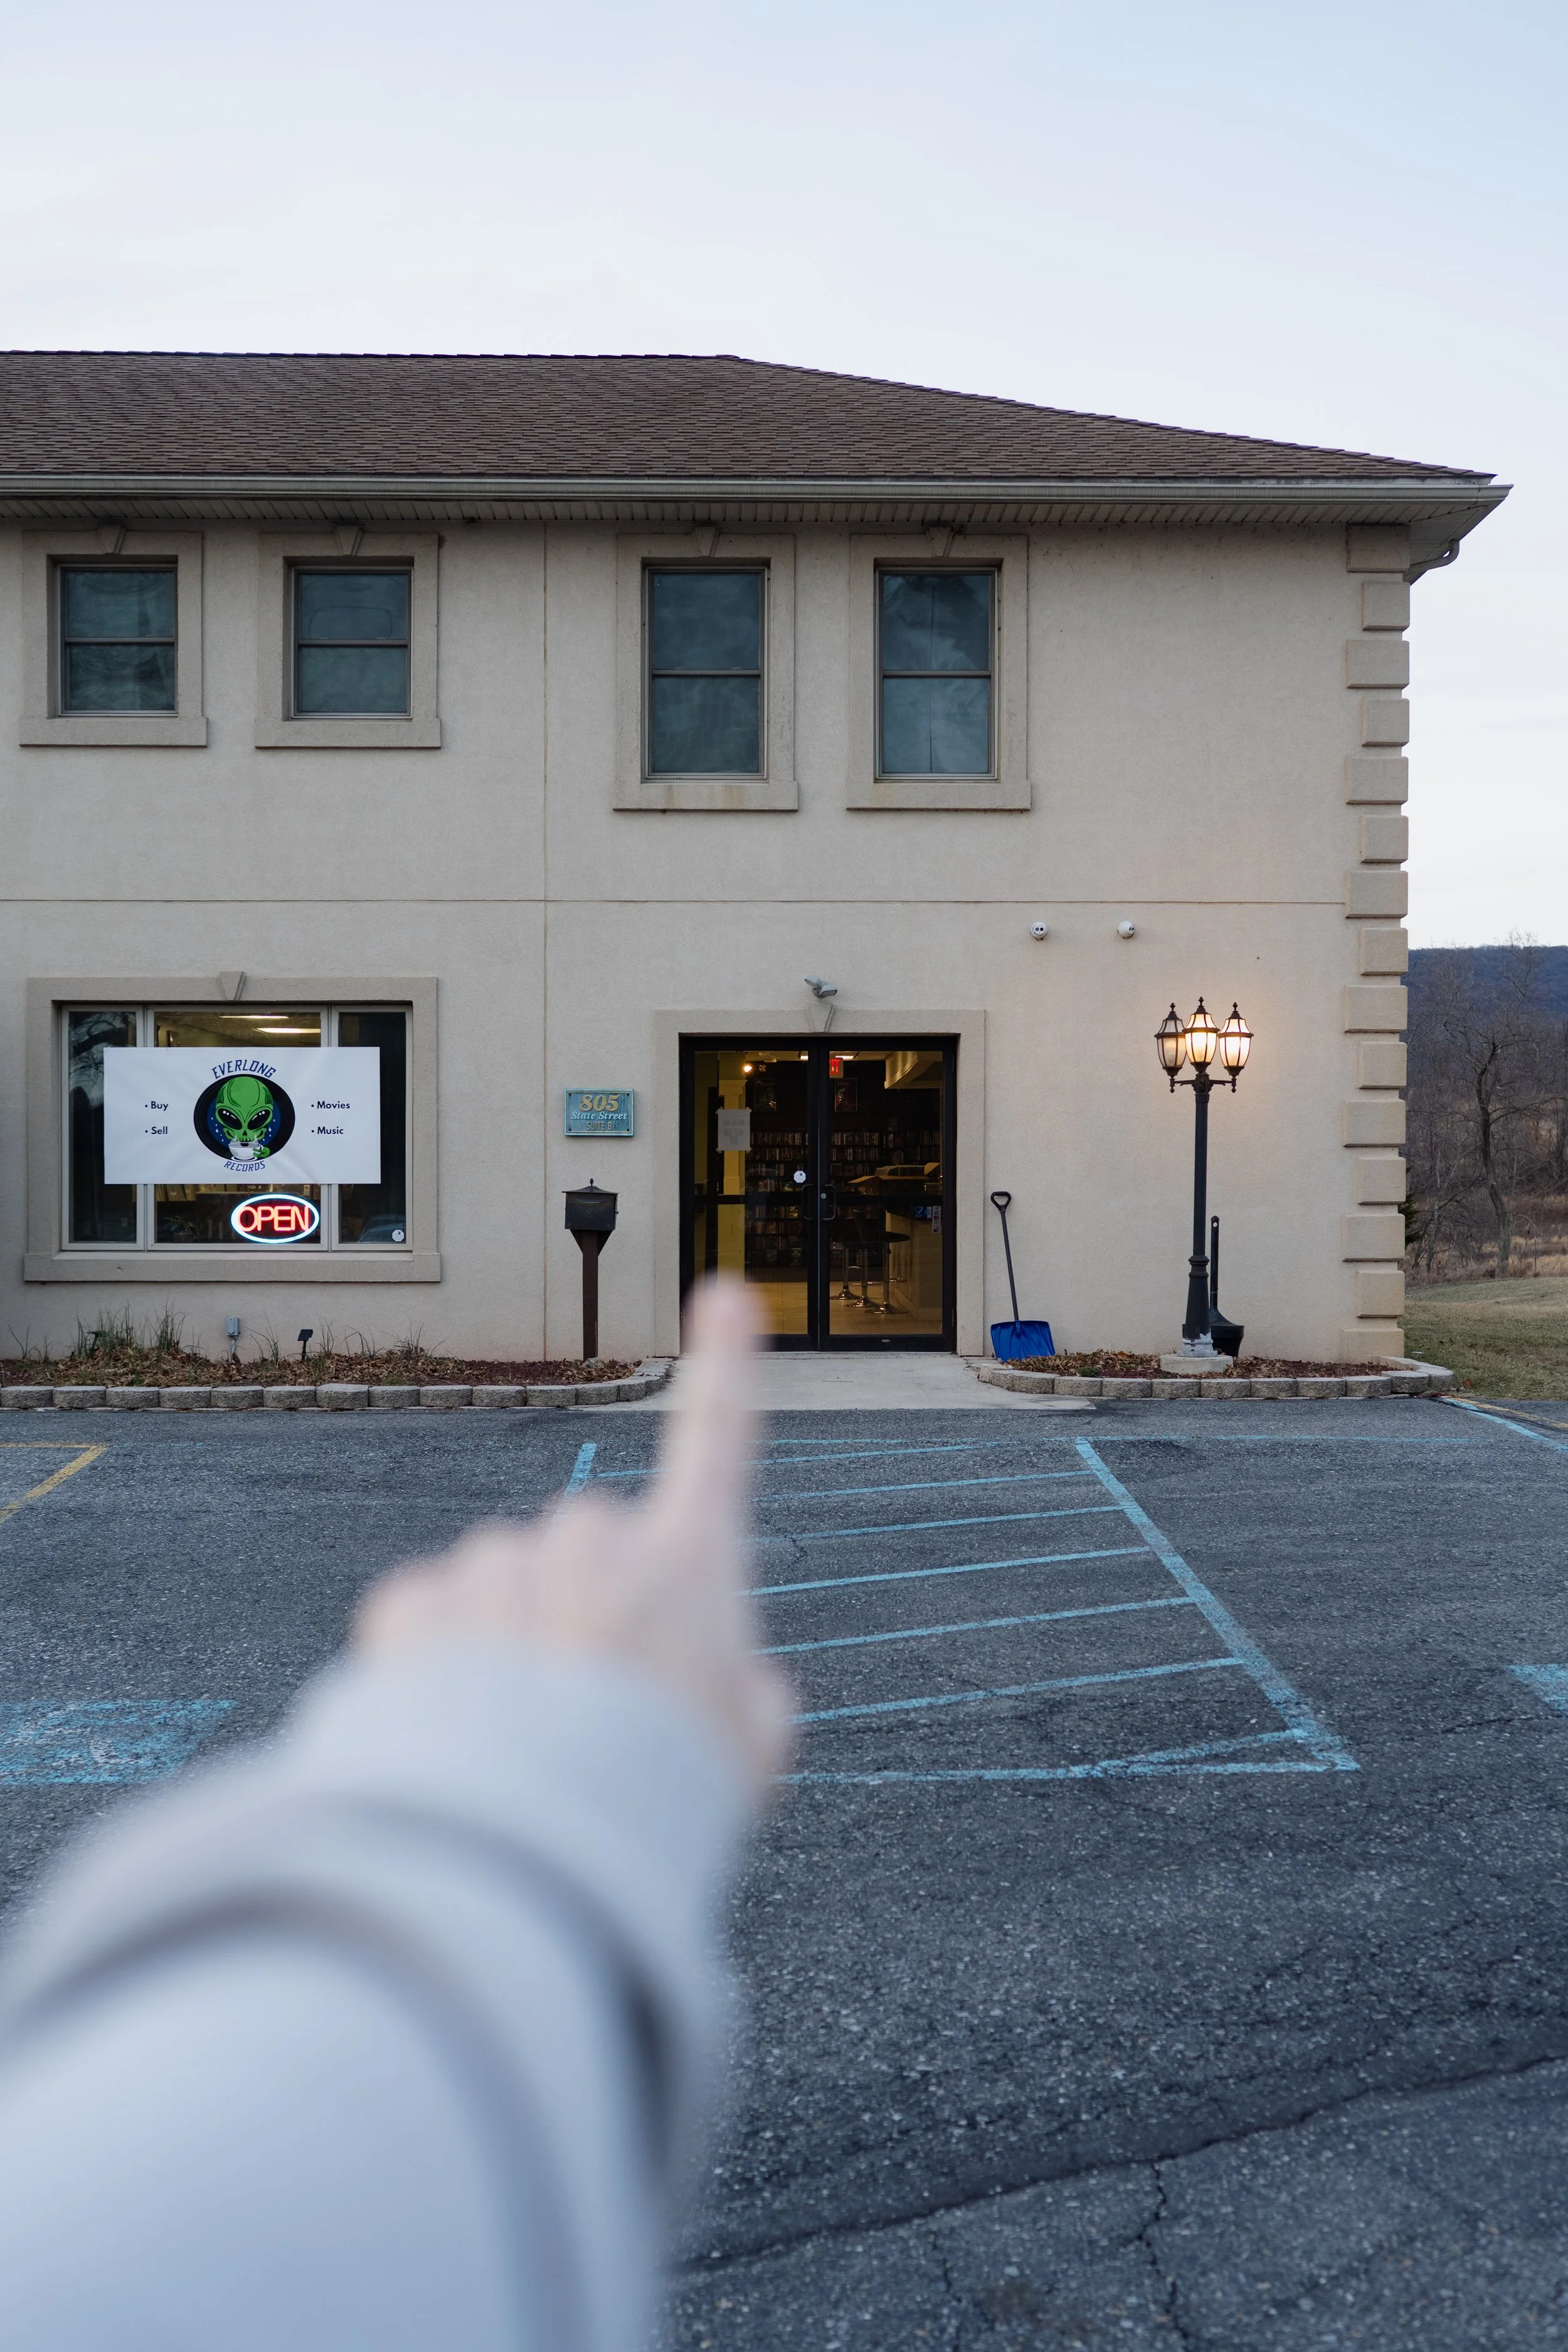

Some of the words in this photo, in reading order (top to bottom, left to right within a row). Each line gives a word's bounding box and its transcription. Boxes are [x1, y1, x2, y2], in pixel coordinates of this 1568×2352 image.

[211, 1059, 276, 1079] EVERLONG
[829, 1059, 839, 1074] IT
[151, 1101, 169, 1111] Buy
[317, 1100, 351, 1109] Movies
[578, 1094, 620, 1111] 805
[571, 1111, 596, 1120] State
[598, 1111, 628, 1120] Street
[151, 1126, 168, 1135] Sell
[317, 1126, 344, 1135] Music
[586, 1121, 605, 1130] SUITE
[608, 1121, 612, 1130] B
[223, 1160, 265, 1172] RECORDS
[238, 1205, 309, 1232] OPEN
